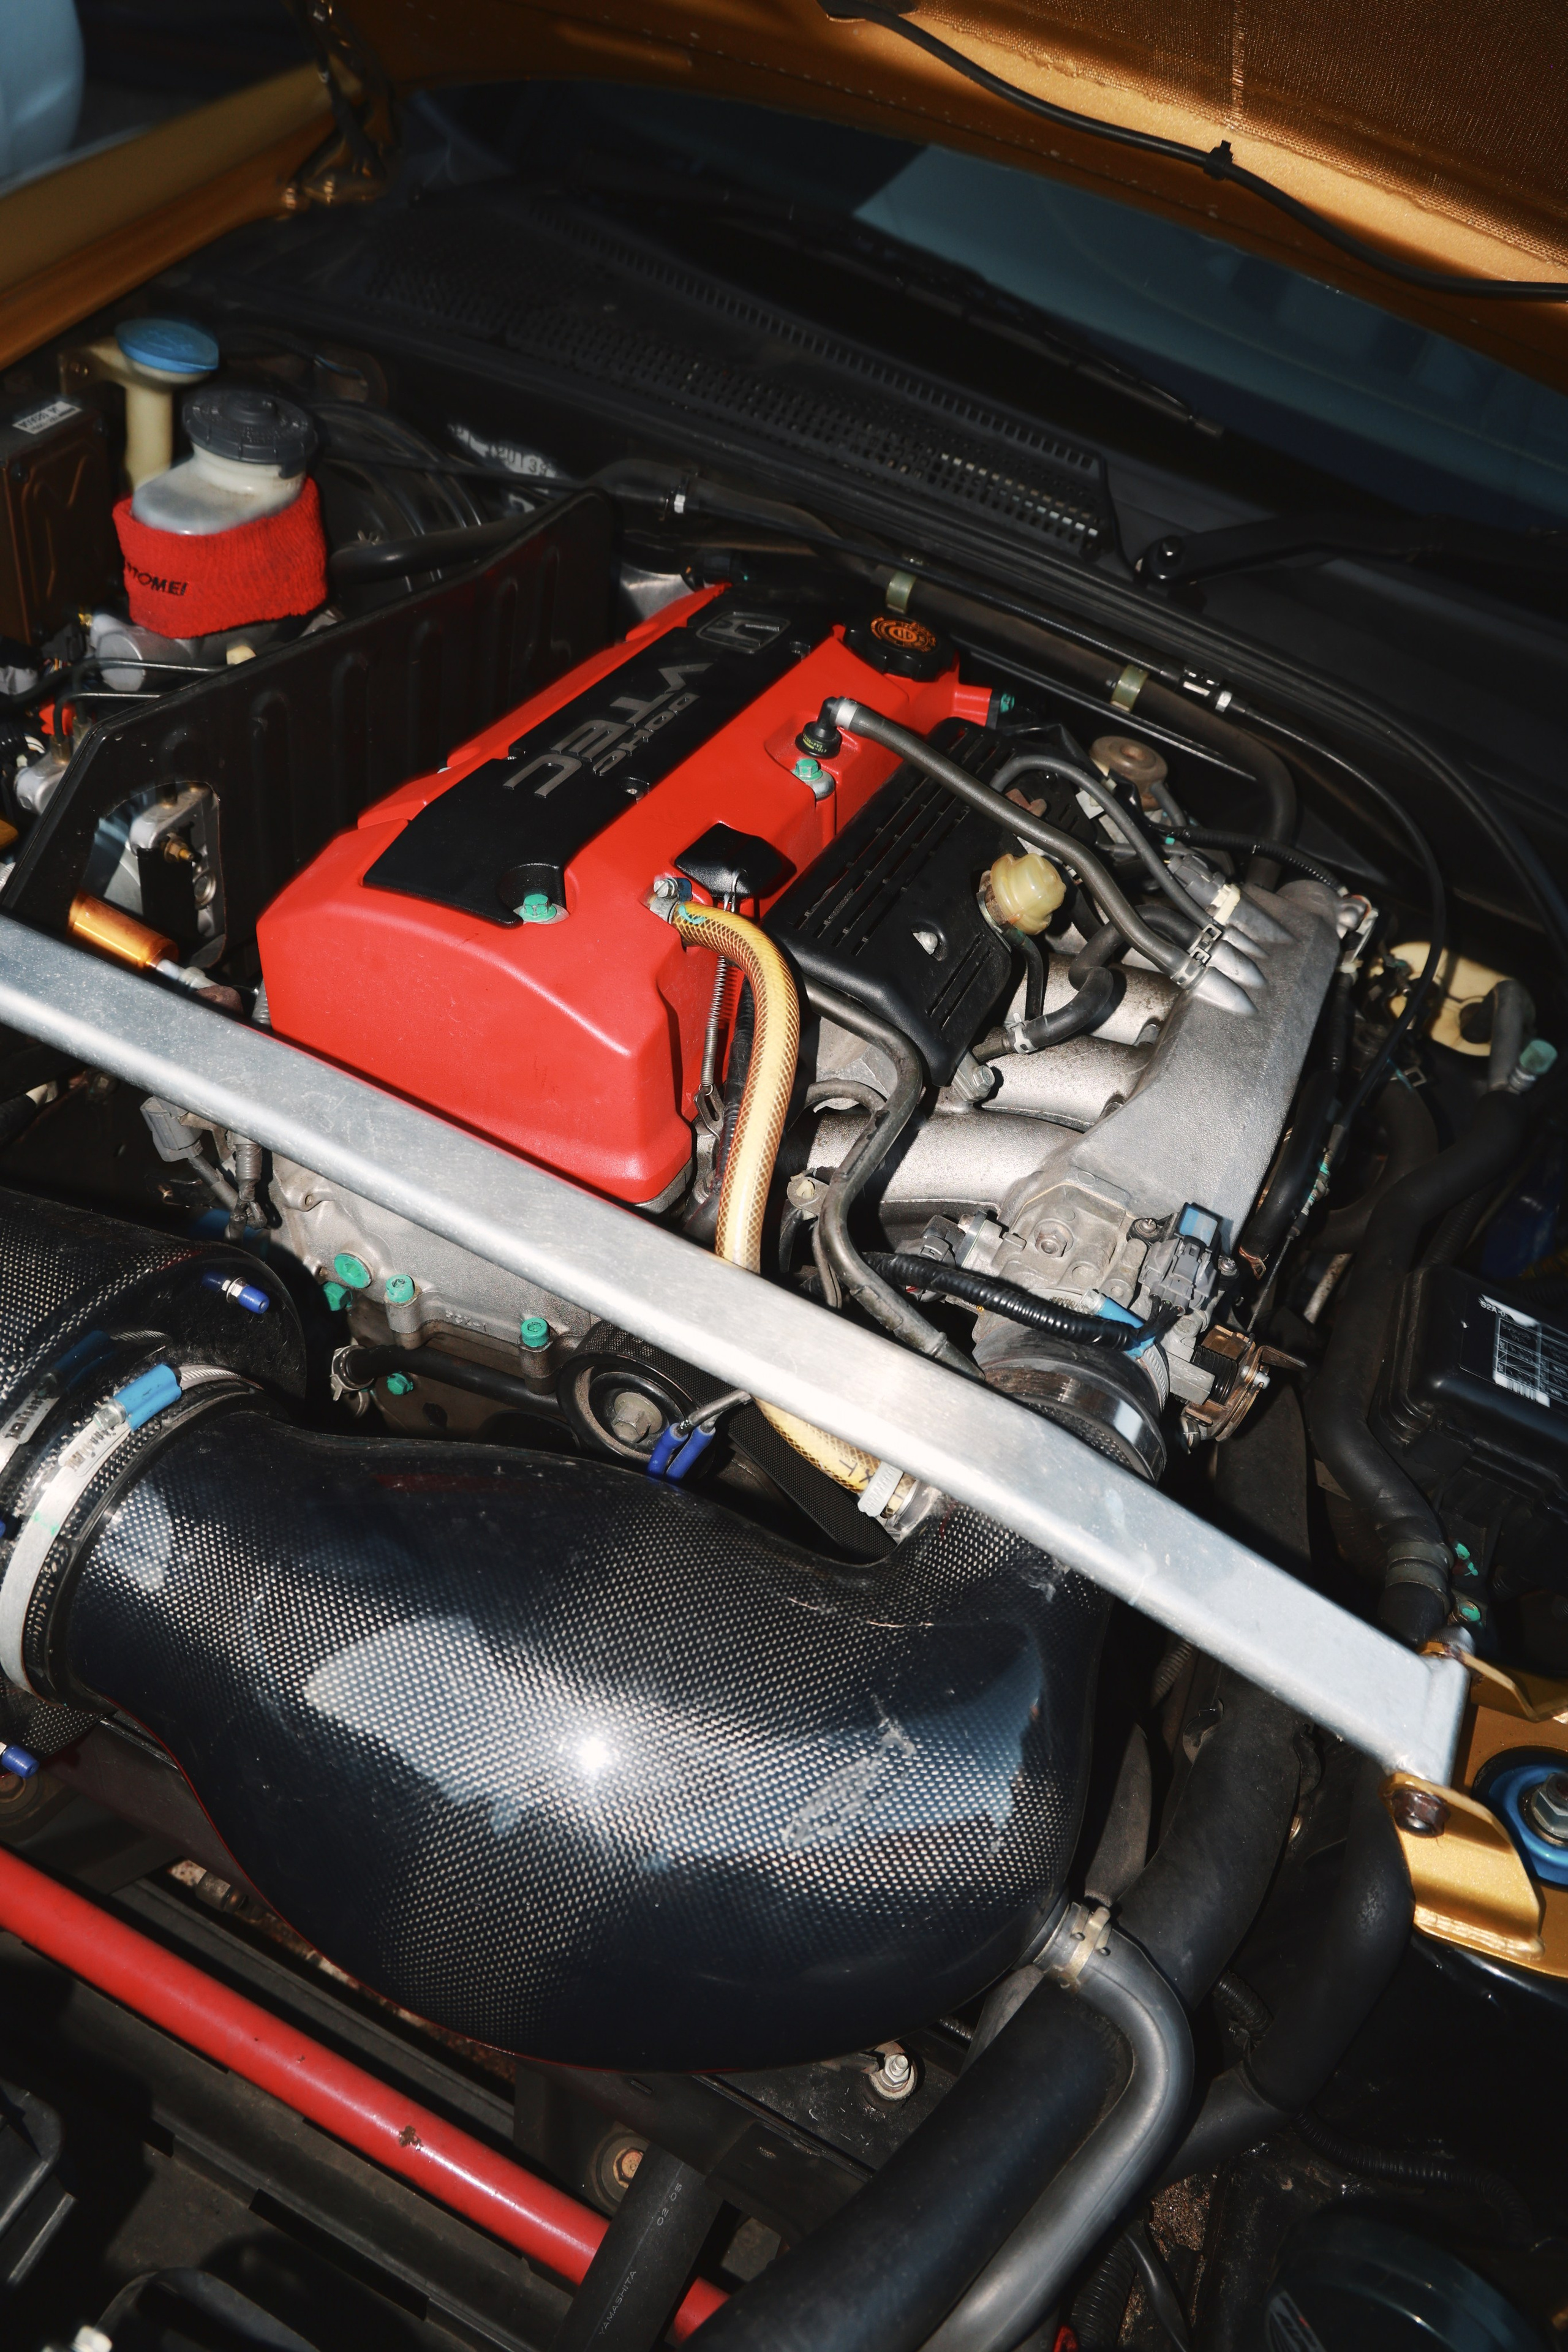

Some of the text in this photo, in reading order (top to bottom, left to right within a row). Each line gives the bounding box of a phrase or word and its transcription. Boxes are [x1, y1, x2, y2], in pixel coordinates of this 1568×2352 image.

[502, 663, 714, 798] VTEC
[592, 692, 701, 775] DOHC
[598, 2270, 637, 2335] YAMASHITA
[657, 2207, 669, 2226] 02
